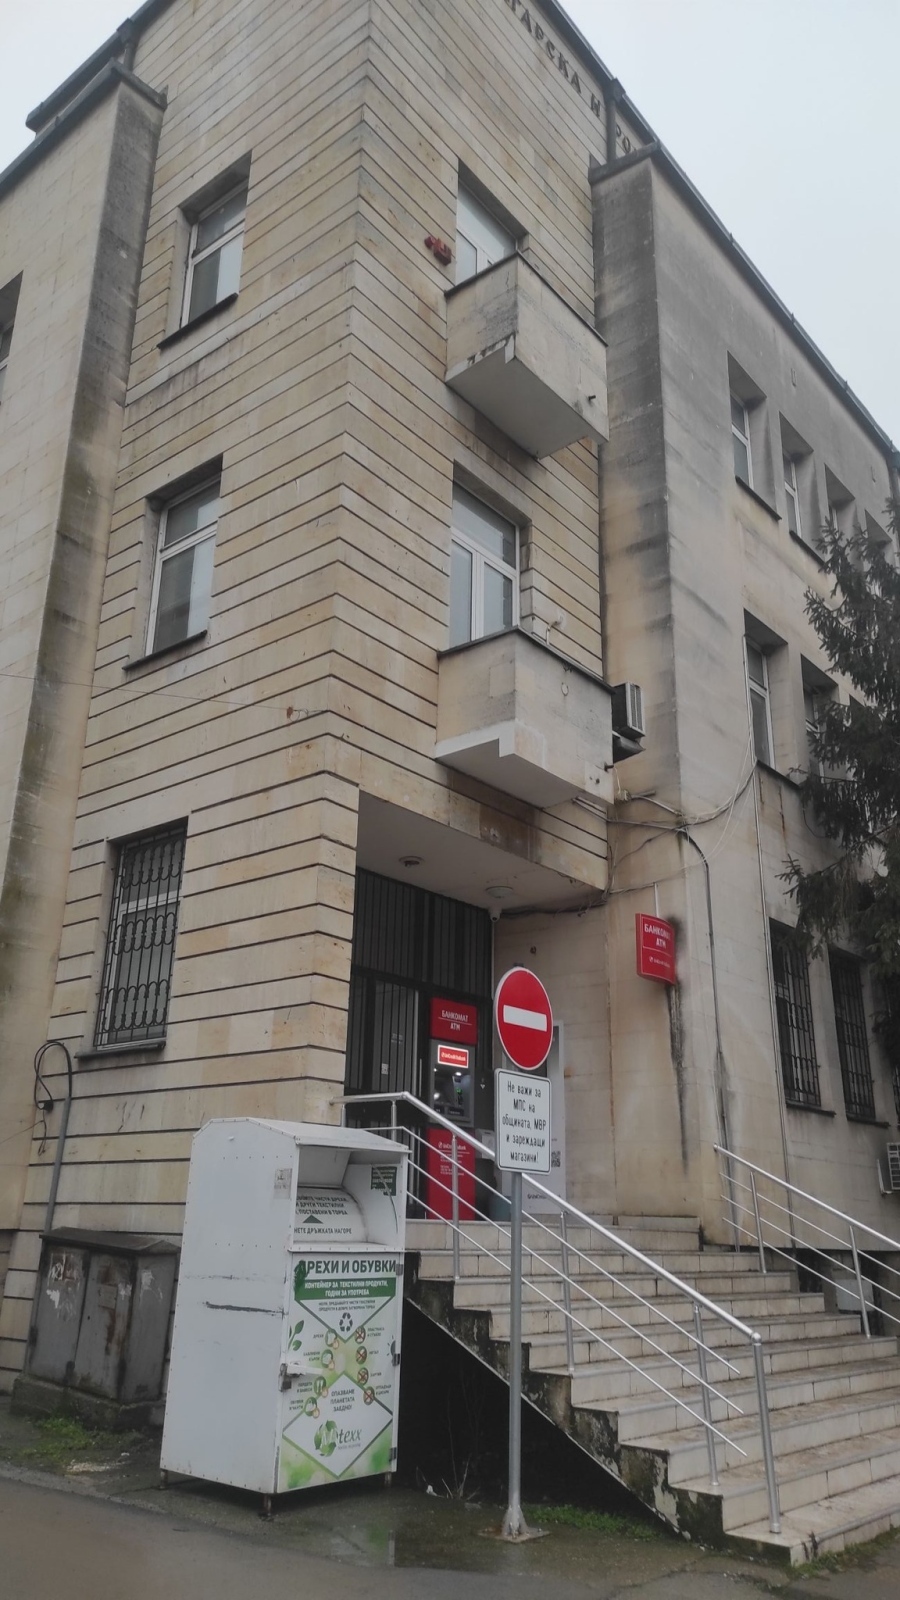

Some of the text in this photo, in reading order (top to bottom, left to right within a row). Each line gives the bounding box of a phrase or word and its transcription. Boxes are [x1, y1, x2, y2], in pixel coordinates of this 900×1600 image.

[441, 1009, 469, 1022] БАНКОМАТ
[450, 1022, 461, 1031] ATM
[507, 1080, 542, 1098] Не важи за
[513, 1098, 536, 1113] МПС на
[502, 1113, 547, 1131] общината, МВР
[506, 1134, 546, 1148] и зареждащи
[510, 1151, 539, 1164] магазини!
[307, 1227, 334, 1235] ДРЪЖКАТА
[334, 1227, 352, 1235] НАГОРЕ
[342, 1260, 350, 1274] И
[352, 1259, 396, 1274] ОБУВКИ
[304, 1281, 333, 1289] КОНТЕЙНЕР
